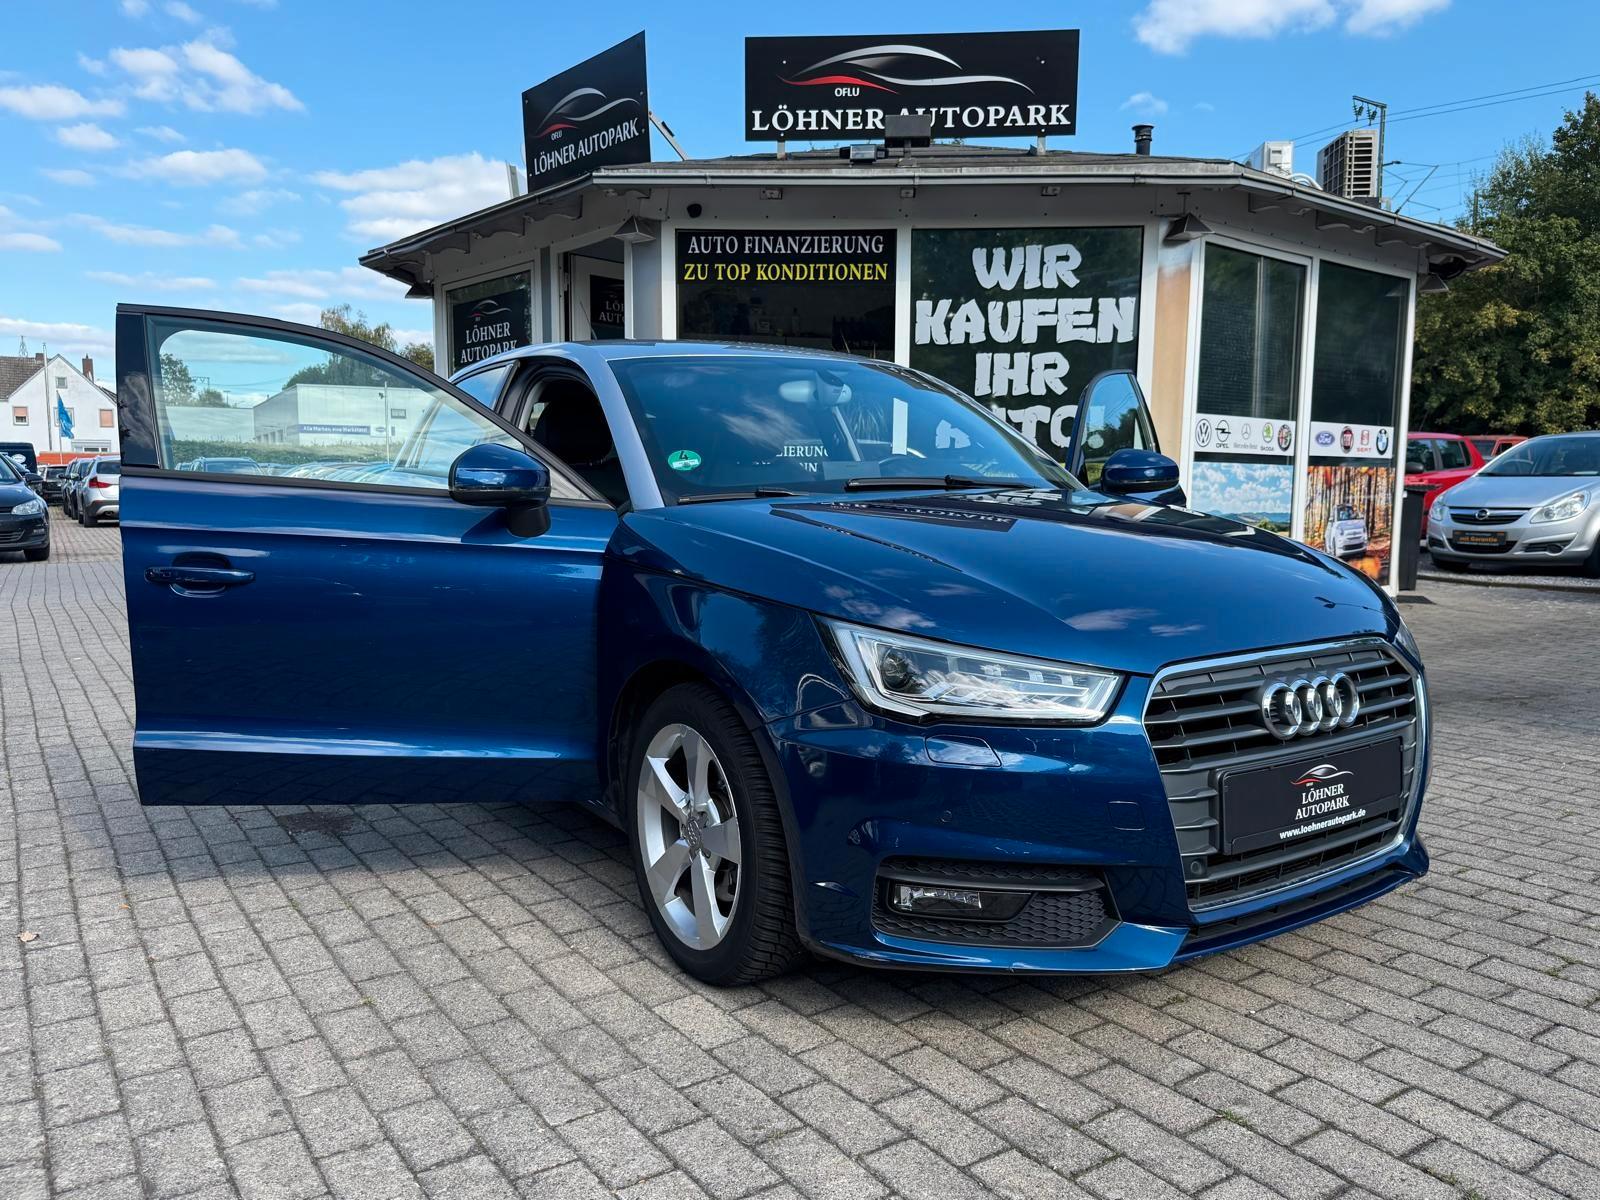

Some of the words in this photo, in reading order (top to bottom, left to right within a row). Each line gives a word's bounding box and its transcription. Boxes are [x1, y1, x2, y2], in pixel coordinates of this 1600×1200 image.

[834, 87, 860, 97] OFLU
[752, 104, 885, 131] LÖHNER
[534, 143, 577, 175] LÖHNER
[577, 117, 639, 158] AUTOPARK
[688, 235, 738, 254] AUTO
[744, 235, 884, 254] FINANZIERUNG
[683, 263, 709, 281] ZU
[715, 263, 751, 281] TOP
[756, 263, 888, 281] KONDITIONEN
[971, 243, 1082, 291] WIR
[465, 321, 511, 345] LÖHNER
[914, 297, 1136, 345] KAUFEN
[974, 352, 1070, 397] IHR
[679, 450, 689, 460] 4
[1302, 783, 1344, 805] LÖHNER
[1295, 795, 1350, 820] AUTOPARK
[1279, 808, 1366, 840] www.loehnerautopark.de
